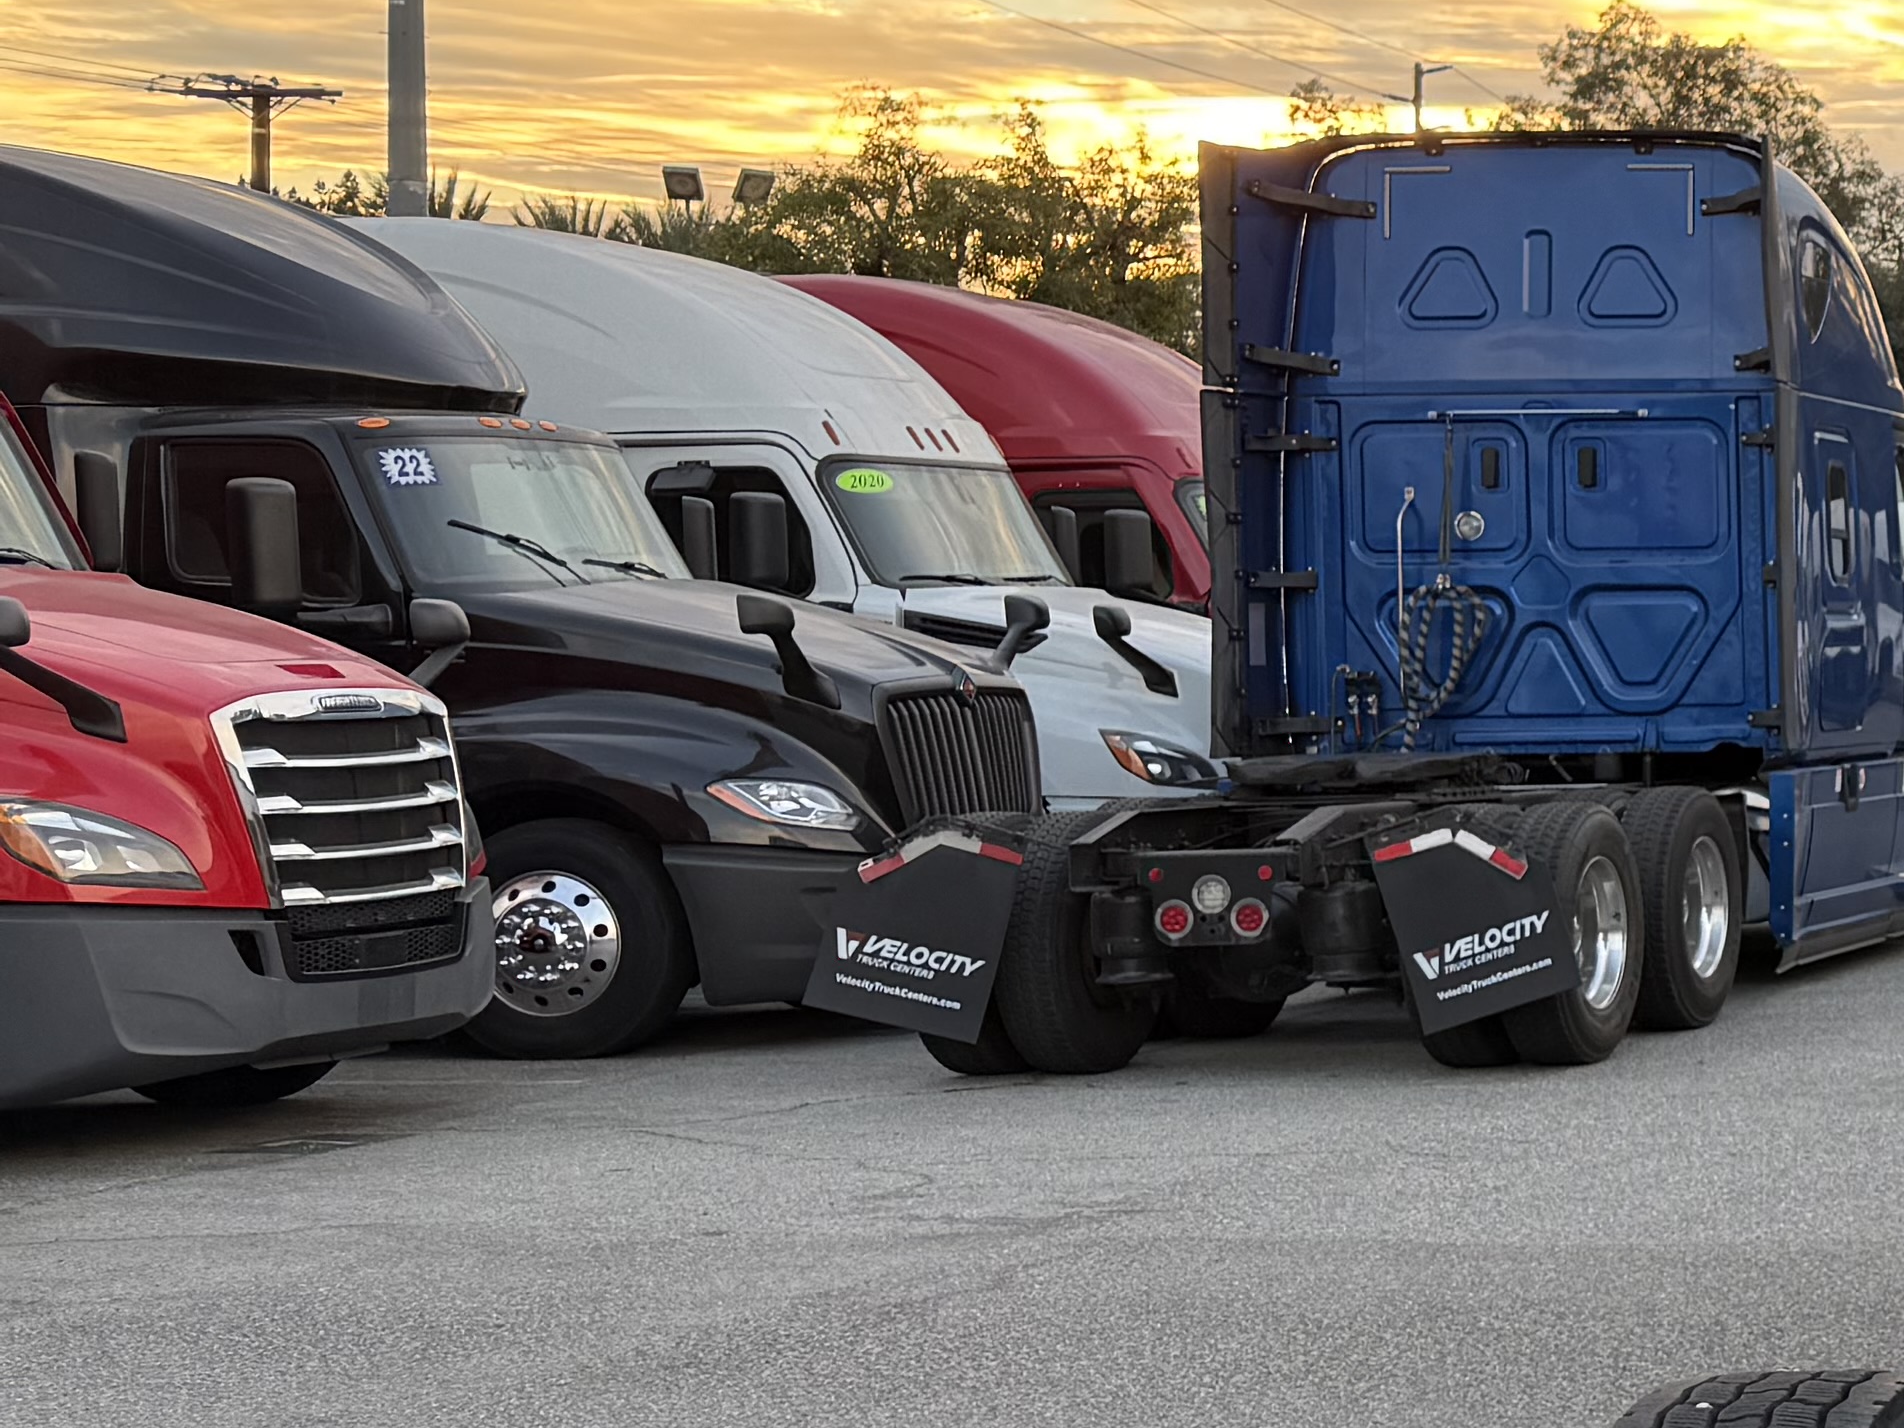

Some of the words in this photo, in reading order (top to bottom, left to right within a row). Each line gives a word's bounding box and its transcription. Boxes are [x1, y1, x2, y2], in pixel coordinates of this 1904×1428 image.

[394, 455, 425, 477] 22
[850, 474, 884, 489] 2020
[1444, 910, 1549, 962] VELOCITY
[857, 954, 890, 969] TRUCK
[890, 958, 935, 980] CENTERS
[862, 935, 986, 976] VELOCITY
[1443, 956, 1473, 974] TRUCK
[1475, 944, 1515, 965] CENTERS
[835, 973, 962, 1010] VelocityTruckCenters.com
[1436, 957, 1553, 1001] VelocityTruckCenters.com
